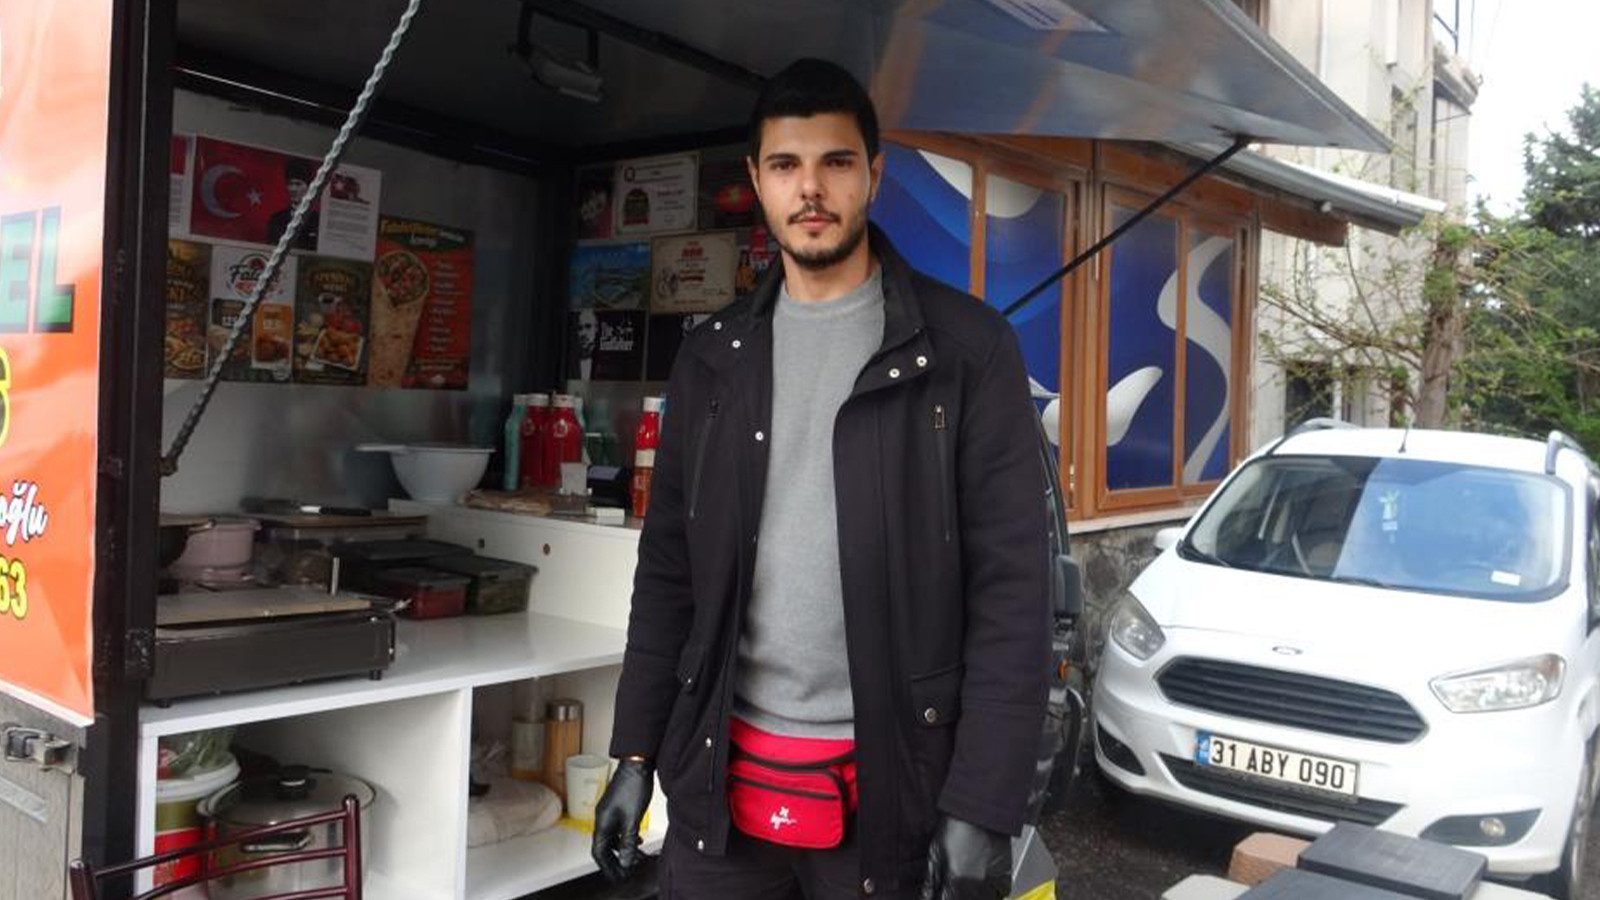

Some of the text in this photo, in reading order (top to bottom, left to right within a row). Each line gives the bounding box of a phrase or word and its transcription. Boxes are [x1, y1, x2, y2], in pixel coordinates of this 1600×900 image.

[0, 206, 76, 334] EL
[1211, 740, 1346, 790] 31 ABY 090
